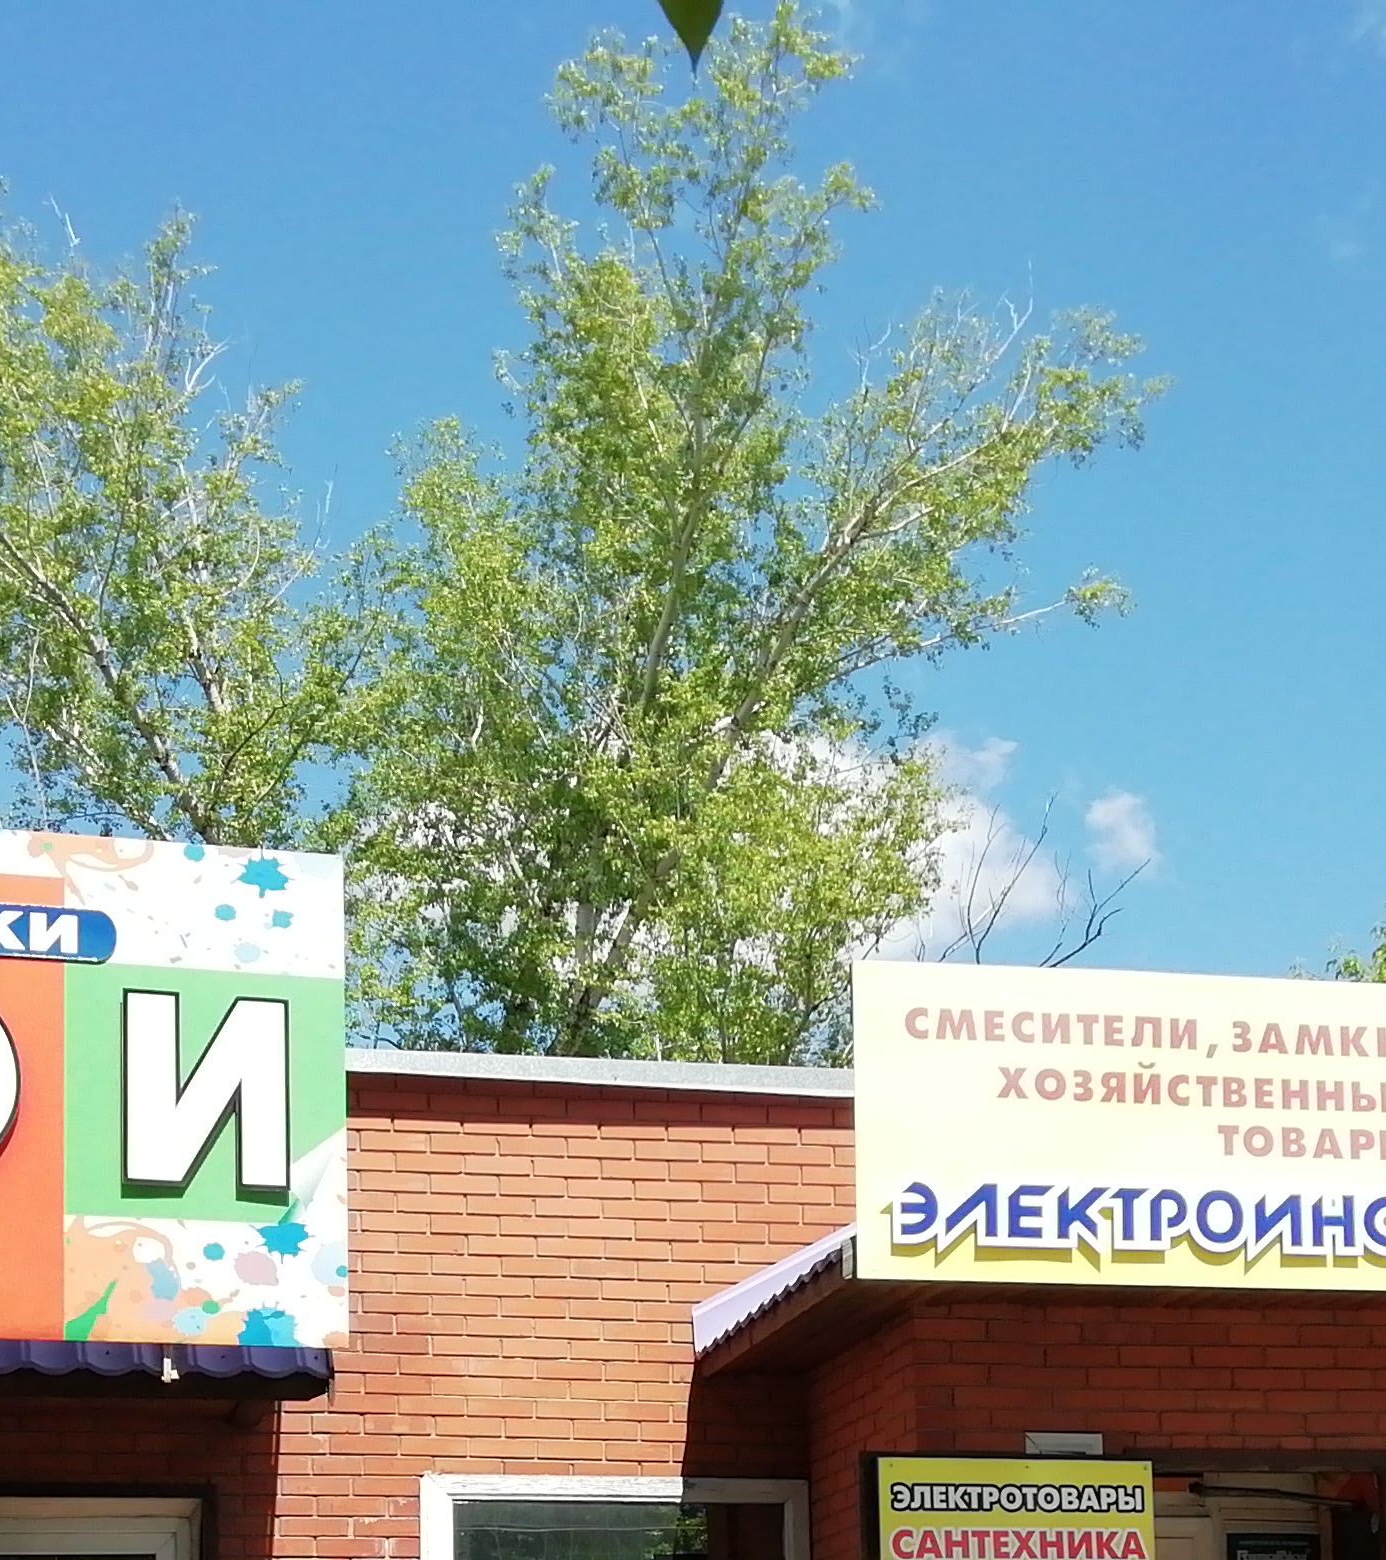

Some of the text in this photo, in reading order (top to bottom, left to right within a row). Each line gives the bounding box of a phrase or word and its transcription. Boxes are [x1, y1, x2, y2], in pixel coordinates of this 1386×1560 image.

[904, 1007, 1219, 1059] СМЕСИТЕЛИ,
[891, 1484, 1144, 1512] ЭЛЕКТРОТОВАРЫ
[892, 1530, 1146, 1560] САНТЕХНИКА
